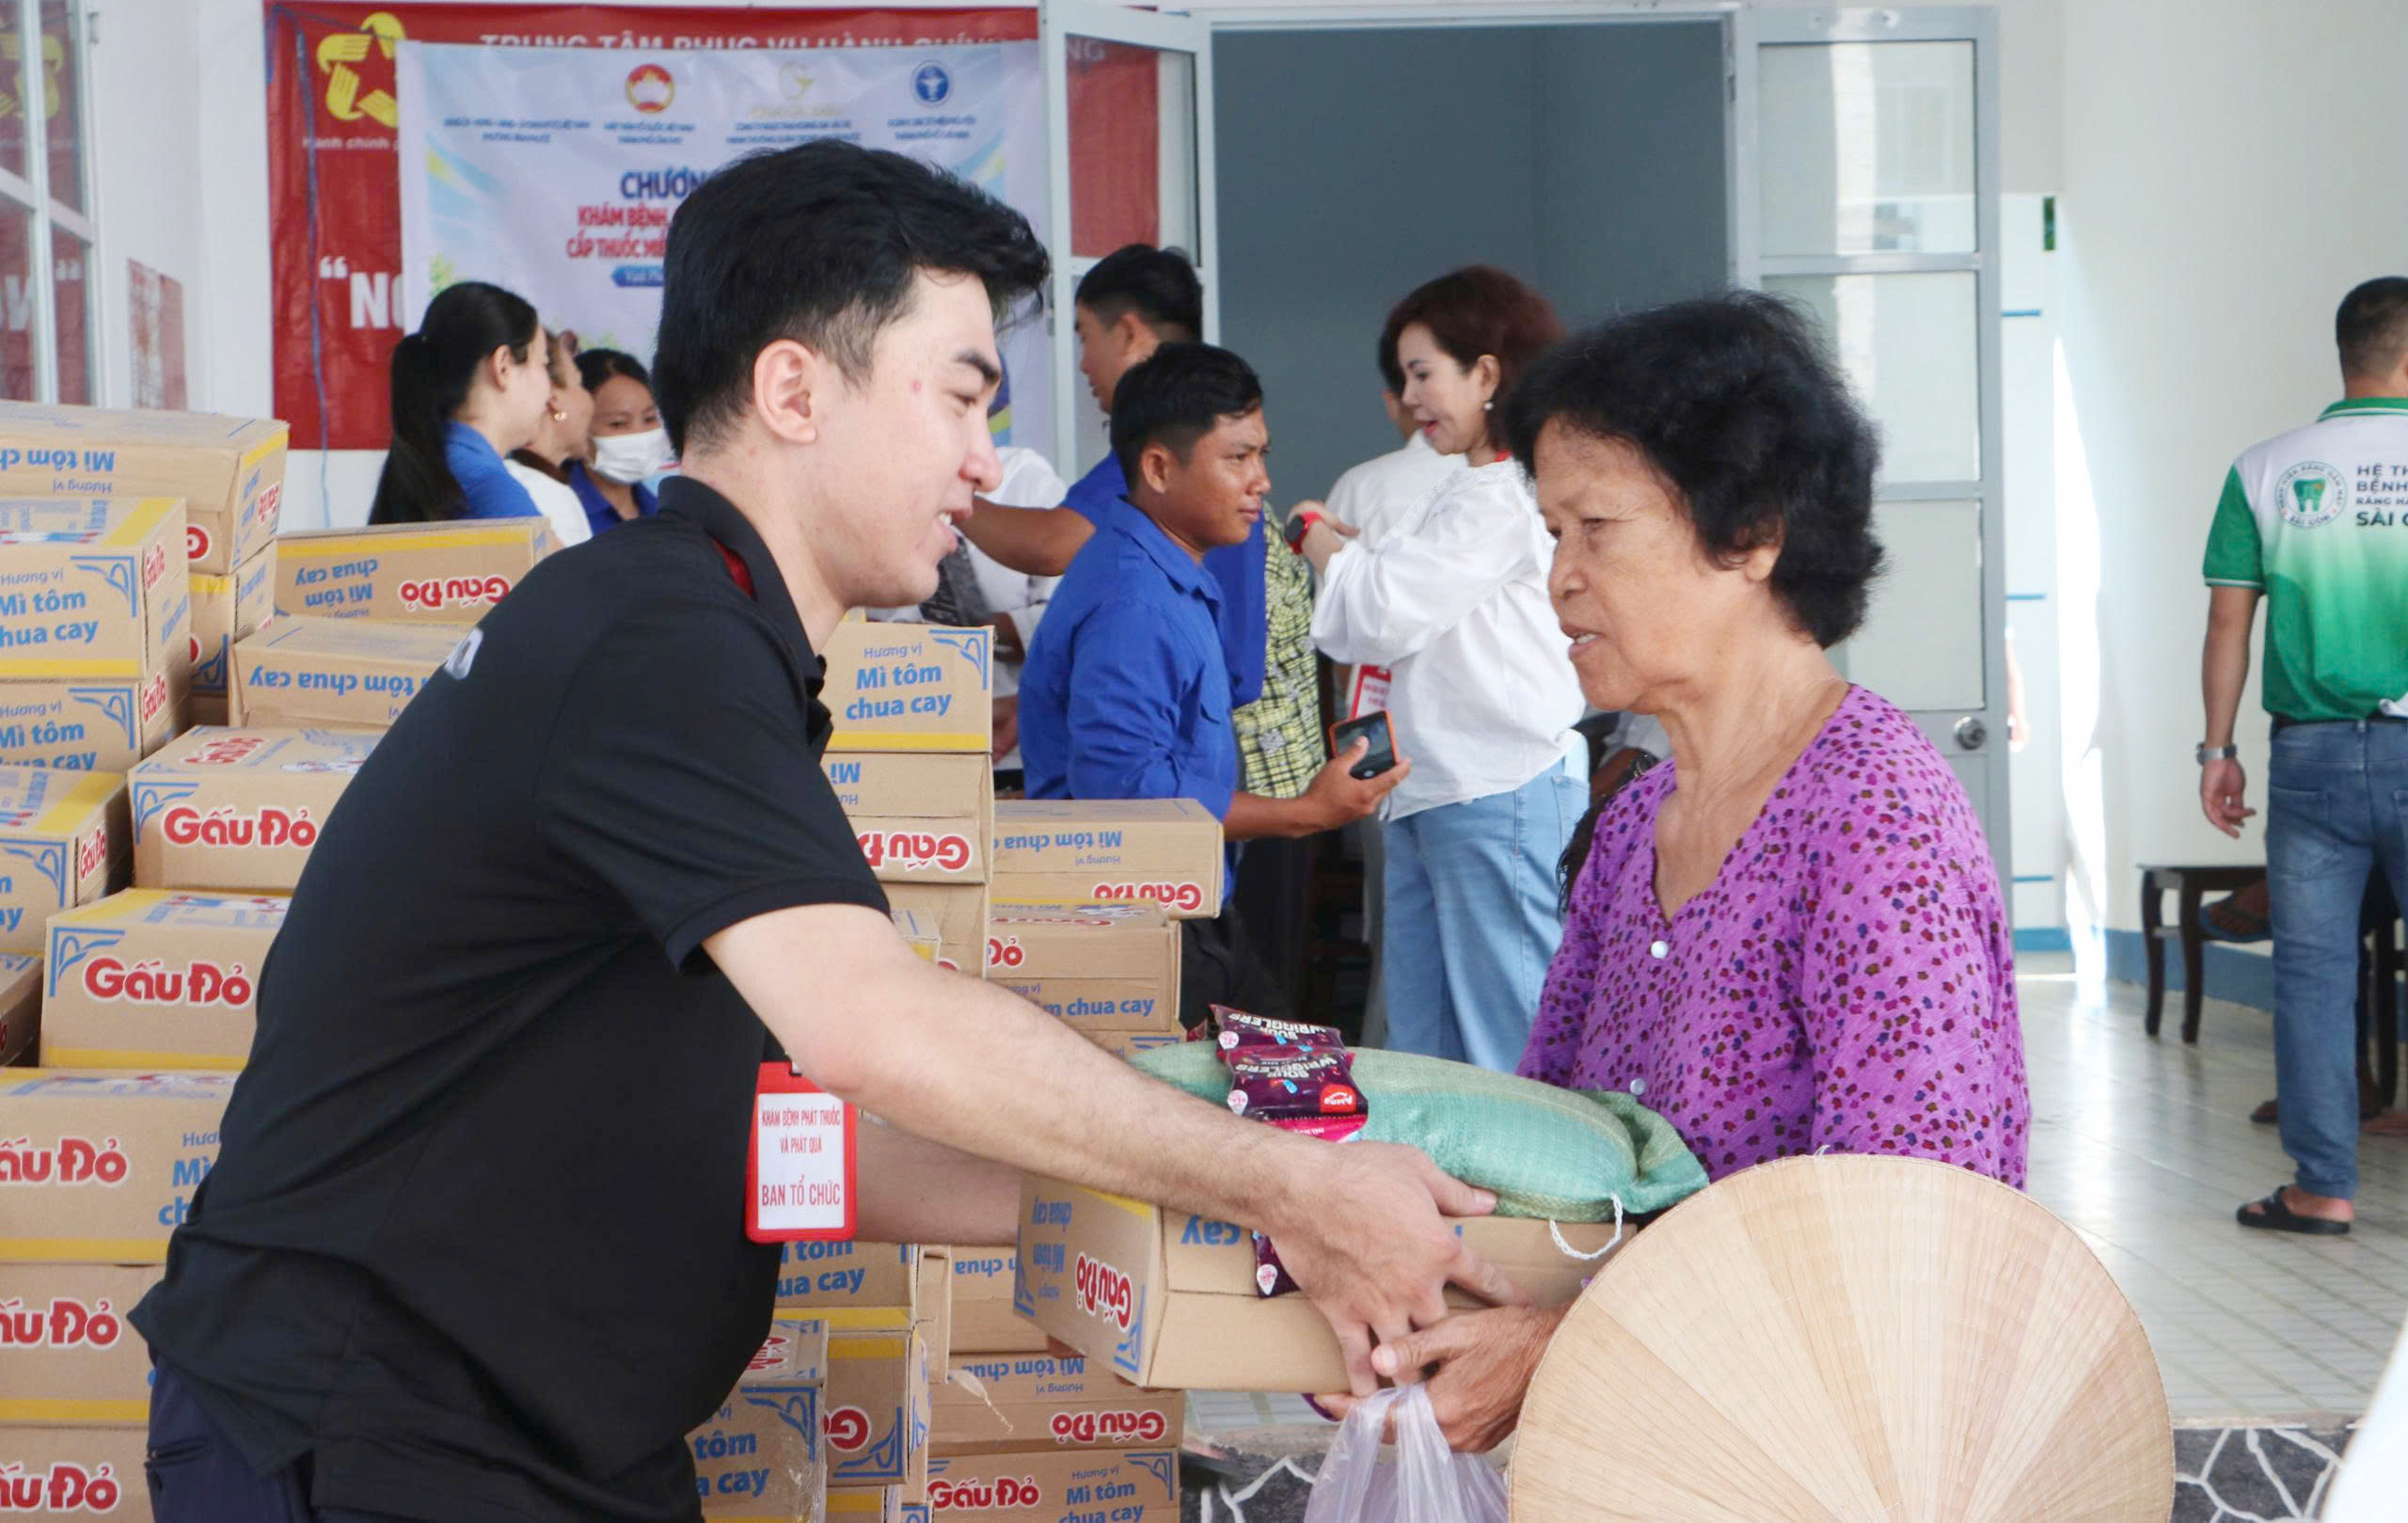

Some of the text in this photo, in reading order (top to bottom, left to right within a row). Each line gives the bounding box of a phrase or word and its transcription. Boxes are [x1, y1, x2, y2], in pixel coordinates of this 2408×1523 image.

[2356, 507, 2395, 527] SÀI
[33, 589, 87, 612] tôm
[0, 620, 99, 648] hua cay
[863, 642, 923, 658] Hương vị
[248, 665, 414, 698] cay chua tôm
[856, 662, 943, 690] Mì tôm
[846, 693, 953, 721] chua cay
[31, 719, 85, 746] tôm
[164, 807, 317, 848] Gấu Đỏ
[1004, 830, 1123, 852] Mì tôm chua
[889, 833, 970, 871] Gấu
[85, 958, 251, 1006] Gấu Đỏ
[1067, 997, 1115, 1017] chua
[1120, 998, 1155, 1017] cay
[762, 1104, 841, 1129] KHÁM BỆNH PHÁT THUỐC
[182, 1131, 222, 1147] Hươ
[780, 1134, 823, 1154] VÀ PHÁT QUÀ
[0, 1137, 127, 1182] ấu Đỏ
[762, 1174, 841, 1207] BAN TỔ CHỨC
[158, 1196, 193, 1226] ch
[1180, 1213, 1242, 1245] cay
[816, 1268, 865, 1294] cay
[955, 1258, 1004, 1277] chua
[50, 1300, 119, 1345] Đỏ
[1015, 1359, 1056, 1377] tôm
[1053, 1411, 1165, 1442] Gấu Đỏ
[694, 1430, 756, 1460] tôm
[47, 1466, 119, 1511] Đỏ
[717, 1467, 770, 1498] cay
[927, 1475, 1039, 1510] Gấu Đỏ
[1066, 1482, 1136, 1506] Mì tôm
[1111, 1504, 1145, 1523] cay
